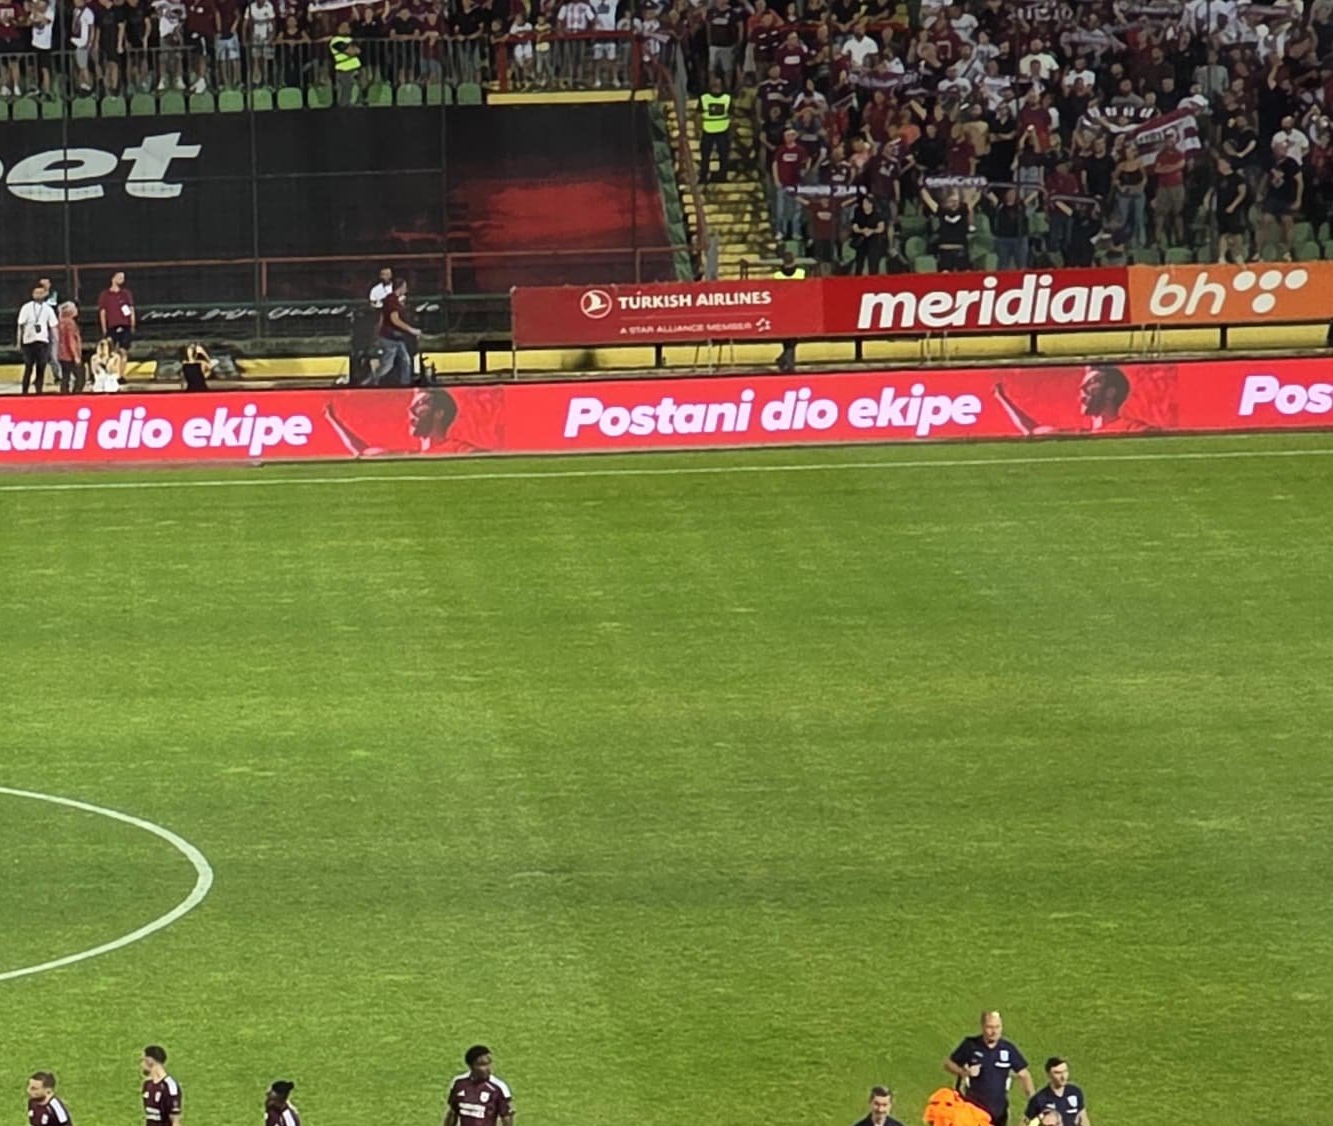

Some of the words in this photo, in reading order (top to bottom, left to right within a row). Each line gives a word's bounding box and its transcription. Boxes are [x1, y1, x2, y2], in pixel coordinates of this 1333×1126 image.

[617, 294, 692, 310] TURKISH
[695, 291, 772, 307] AIRLINES
[857, 274, 1127, 330] meridian
[1149, 272, 1227, 317] bh
[97, 406, 173, 450] dio
[183, 404, 312, 456] ekipe
[564, 389, 755, 438] Postani
[761, 387, 838, 431] dio
[848, 383, 982, 436] ekipe
